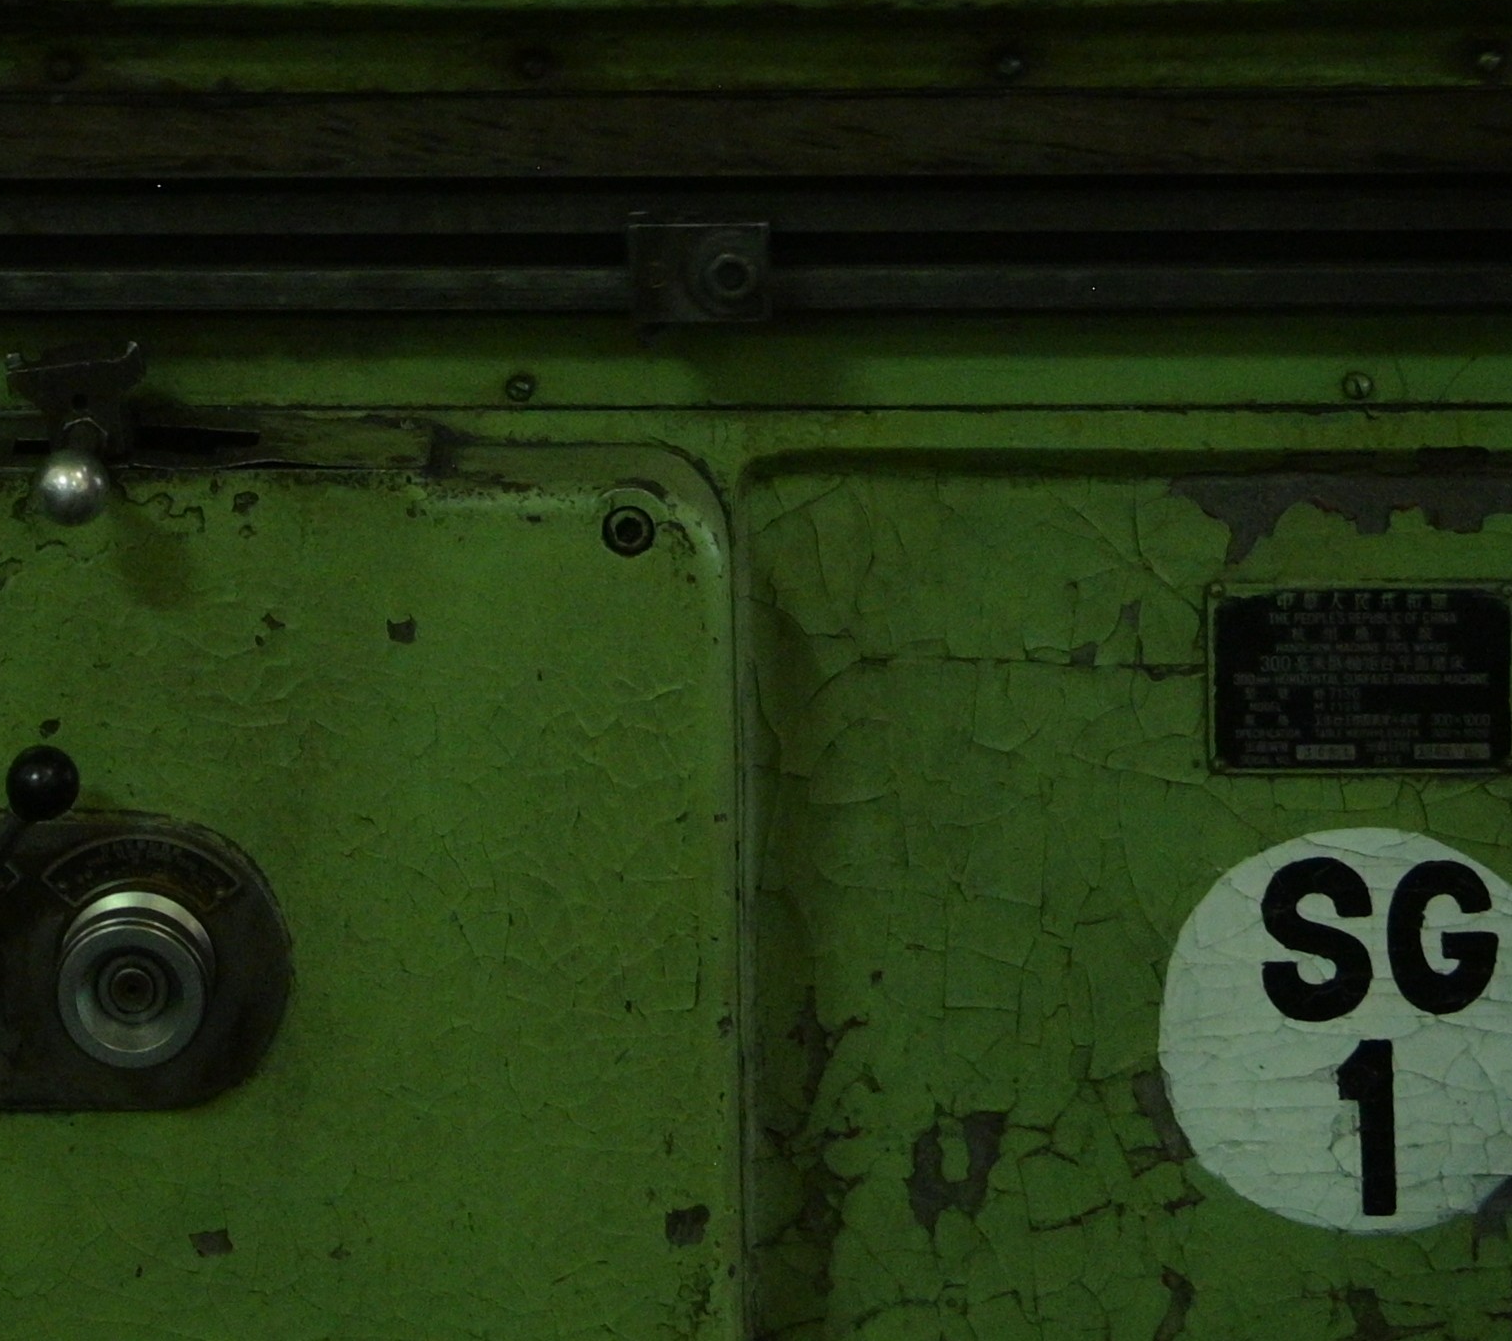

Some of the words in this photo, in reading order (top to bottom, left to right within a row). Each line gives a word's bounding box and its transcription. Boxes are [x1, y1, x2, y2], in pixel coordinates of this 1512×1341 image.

[1259, 655, 1291, 672] 300
[1268, 612, 1290, 625] THE
[1348, 612, 1402, 625] REPUBLIC
[1404, 612, 1418, 625] OF
[1260, 856, 1500, 1022] SG
[1336, 1038, 1397, 1216] 1
